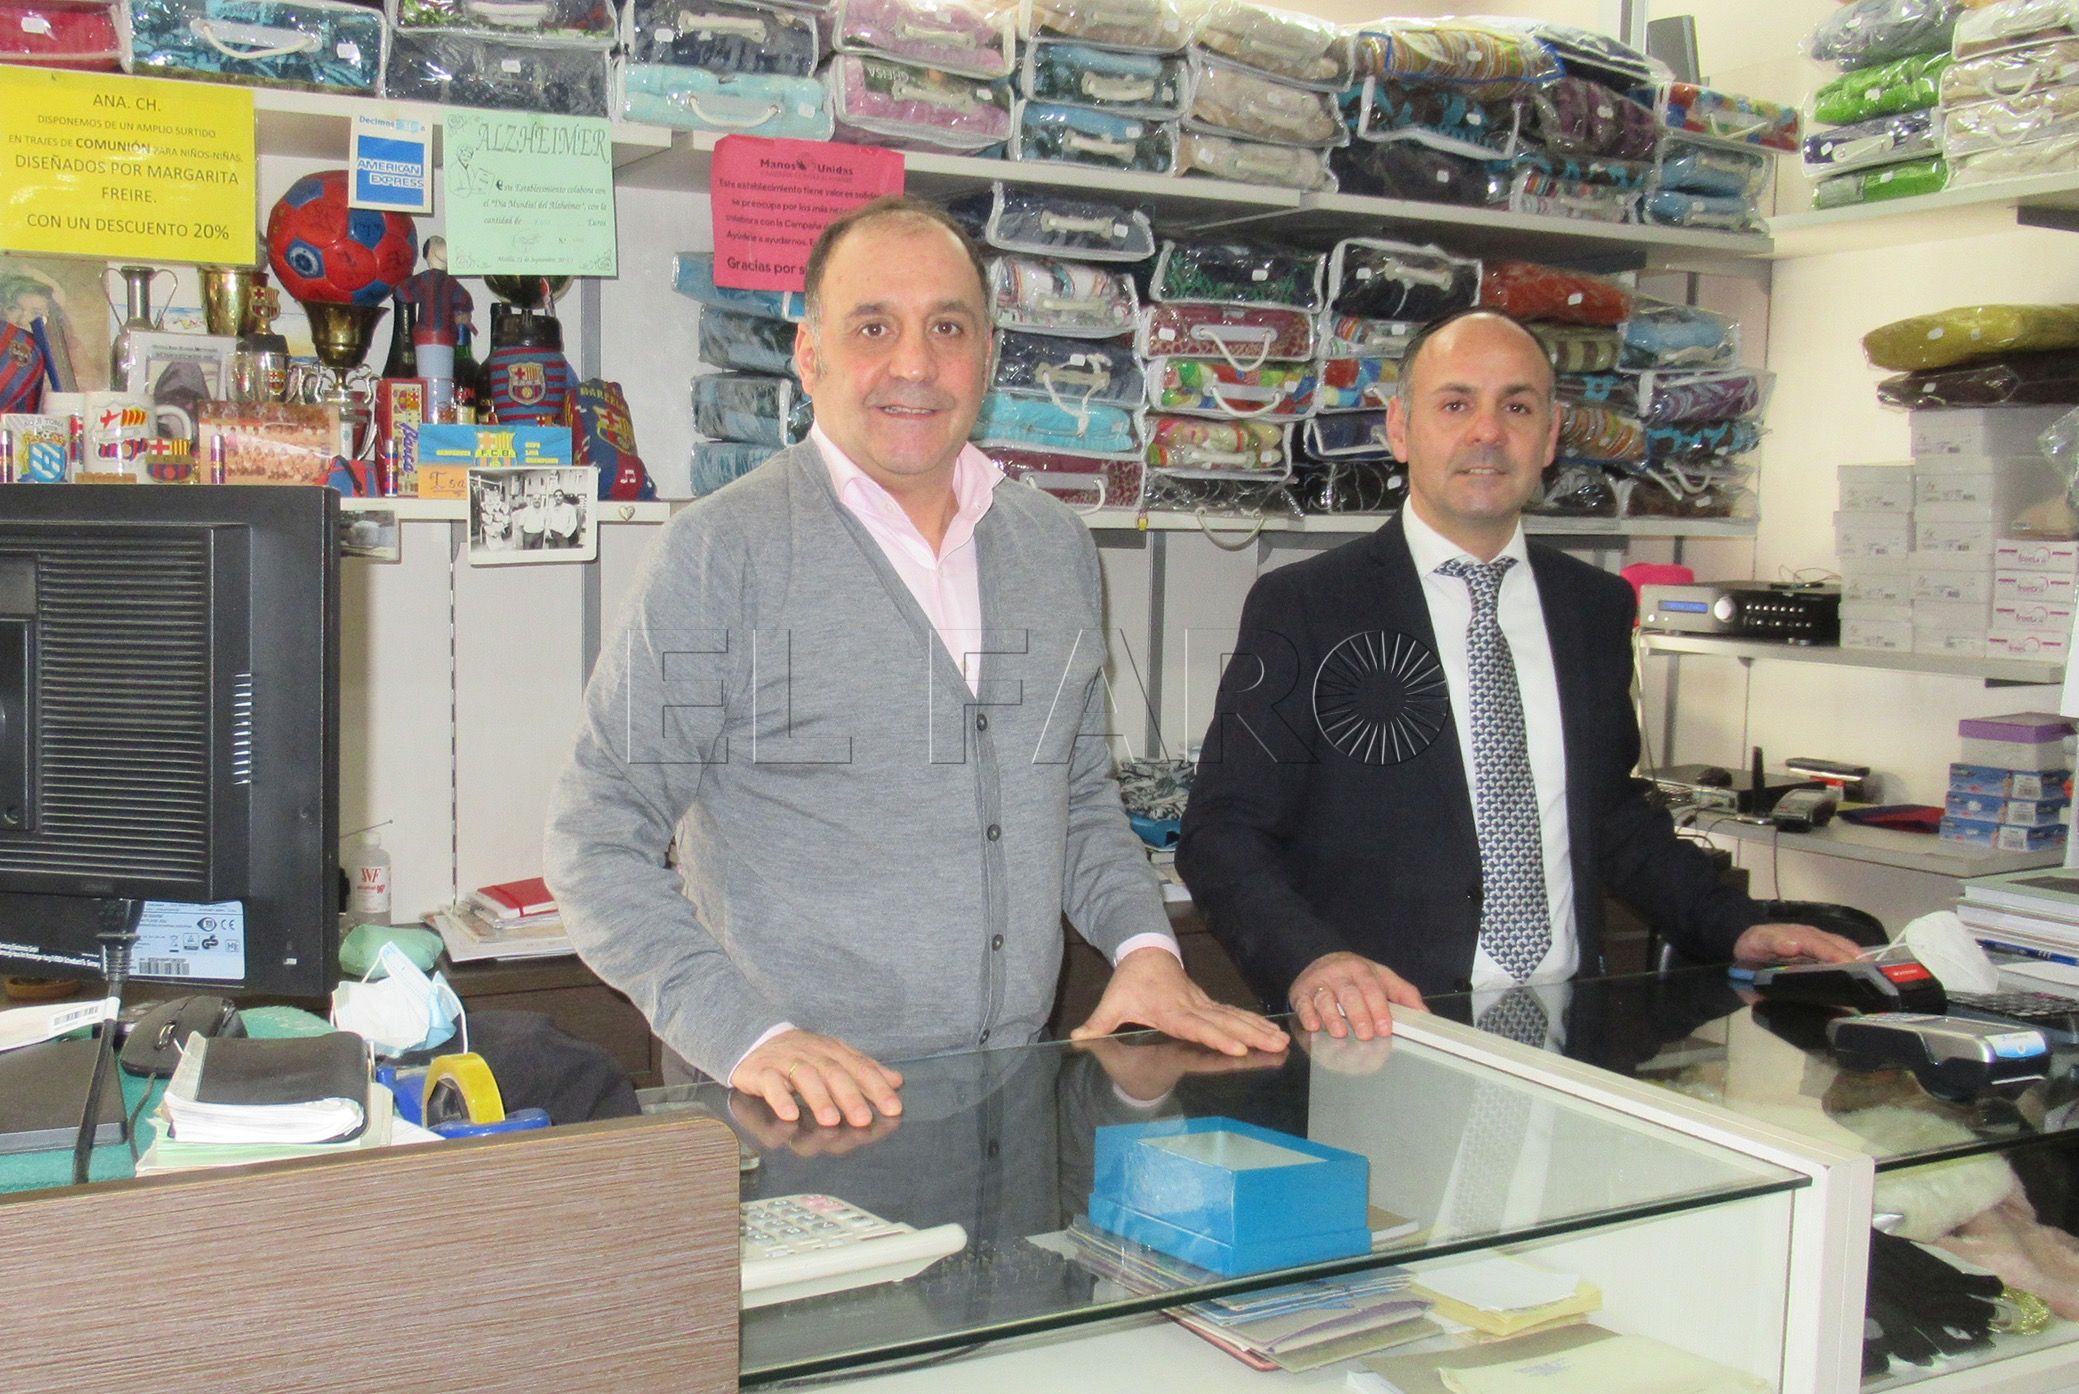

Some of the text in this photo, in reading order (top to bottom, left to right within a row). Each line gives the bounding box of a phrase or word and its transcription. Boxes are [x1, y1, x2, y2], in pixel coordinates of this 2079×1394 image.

[93, 94, 161, 112] ANA. CH.
[38, 114, 216, 138] DISPONEMOS DE UN AMPLIO SURTIDO
[359, 115, 395, 127] Decimos
[9, 134, 22, 144] EN
[25, 135, 57, 147] TRAJES
[60, 138, 74, 147] DE
[75, 137, 150, 154] COMUNIÓN
[153, 147, 178, 156] PARA
[476, 121, 609, 163] ALZHEIMER
[15, 153, 239, 185] DISEÑADOS POR MARGARITA
[358, 159, 420, 174] AMERICAN
[760, 159, 853, 176] Manos Unidas
[371, 174, 424, 188] EXPRESS
[737, 181, 801, 195] establecimiento
[803, 186, 823, 195] tiene
[102, 187, 157, 203] FREIRE.
[742, 200, 781, 211] preocupa
[783, 203, 797, 212] por
[27, 213, 229, 240] CON UN DESCUENTO 20%
[785, 219, 822, 232] Campaña
[727, 256, 771, 273] Gracias
[774, 262, 795, 275] por
